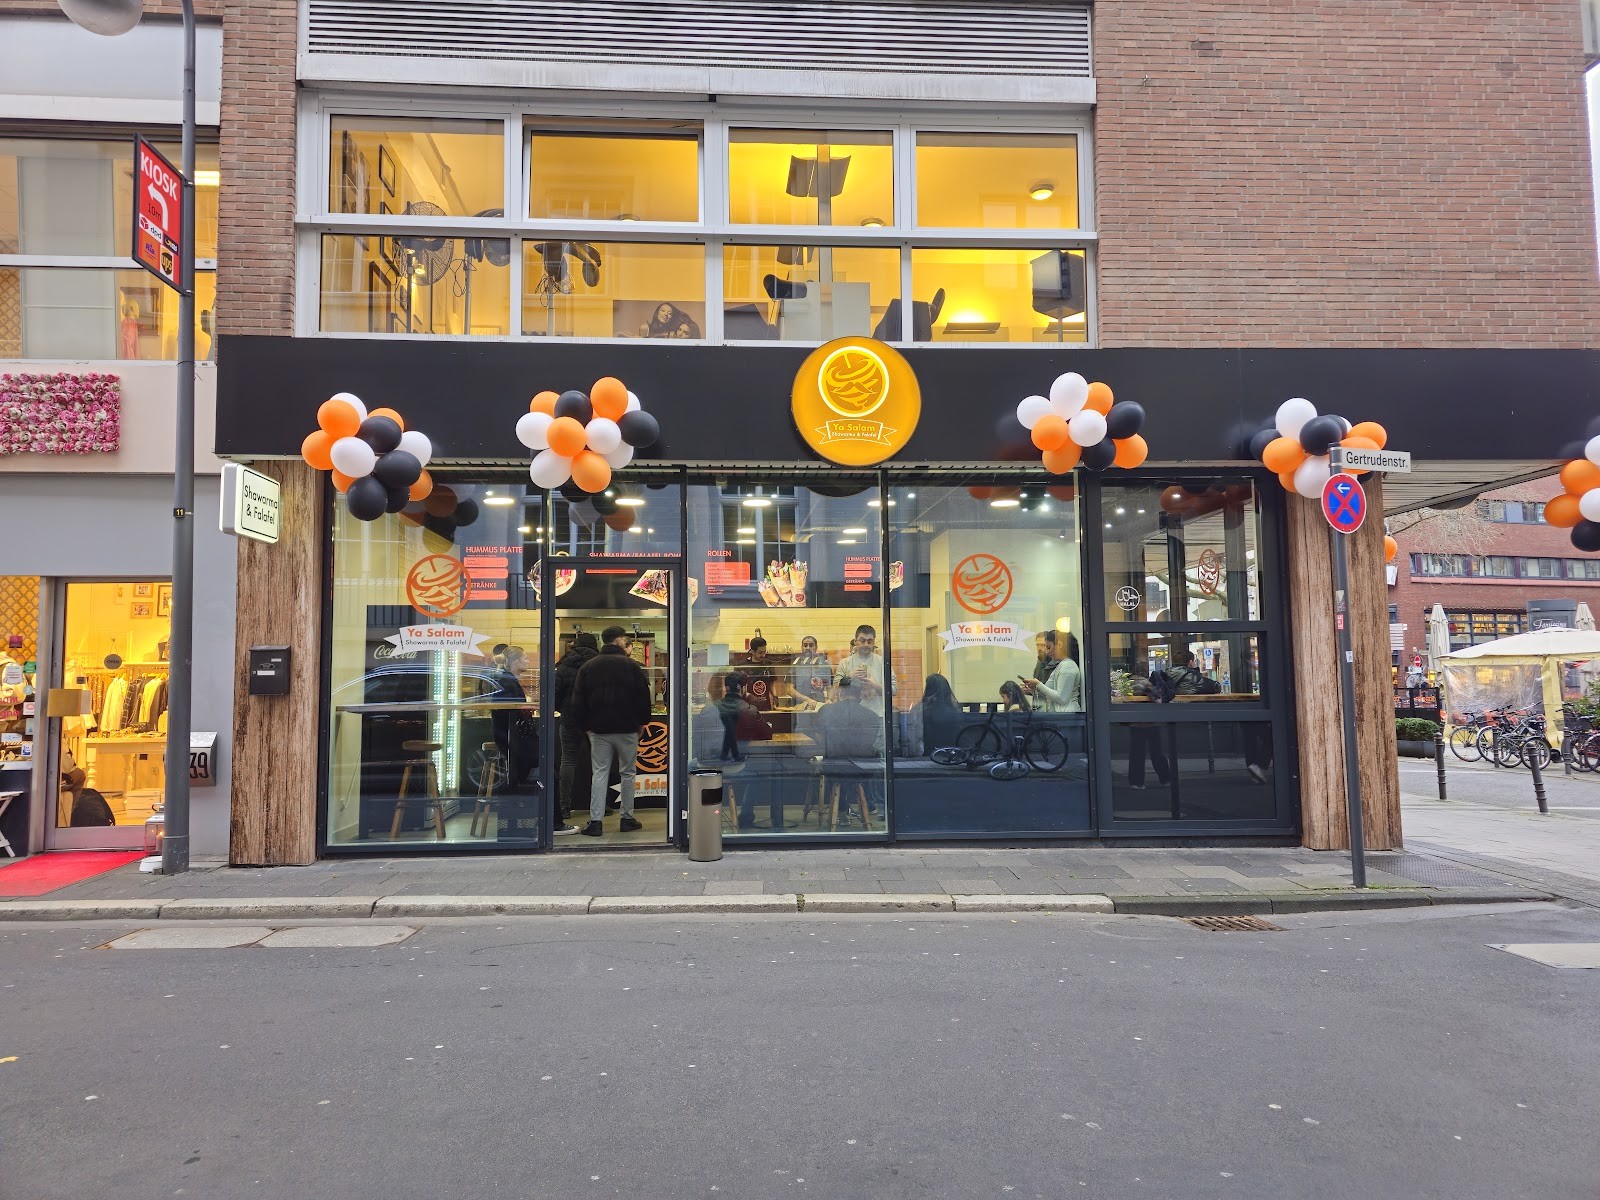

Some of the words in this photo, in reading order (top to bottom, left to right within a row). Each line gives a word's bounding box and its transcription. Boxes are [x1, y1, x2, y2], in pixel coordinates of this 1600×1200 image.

[140, 151, 177, 201] KIOSK
[147, 203, 162, 222] 10m
[150, 226, 162, 241] dpd
[161, 253, 173, 271] ups
[833, 423, 845, 431] Ya
[847, 423, 875, 432] Salam
[1346, 451, 1409, 468] Gertrudenstr.
[244, 485, 278, 509] Shawarma
[246, 504, 252, 517] &
[254, 507, 275, 525] Falafel
[499, 546, 523, 554] PLATTE
[407, 628, 423, 638] Ya
[427, 627, 465, 638] Salam
[957, 624, 972, 634] Ya
[976, 624, 1012, 634] Salam
[644, 778, 667, 790] Sala
